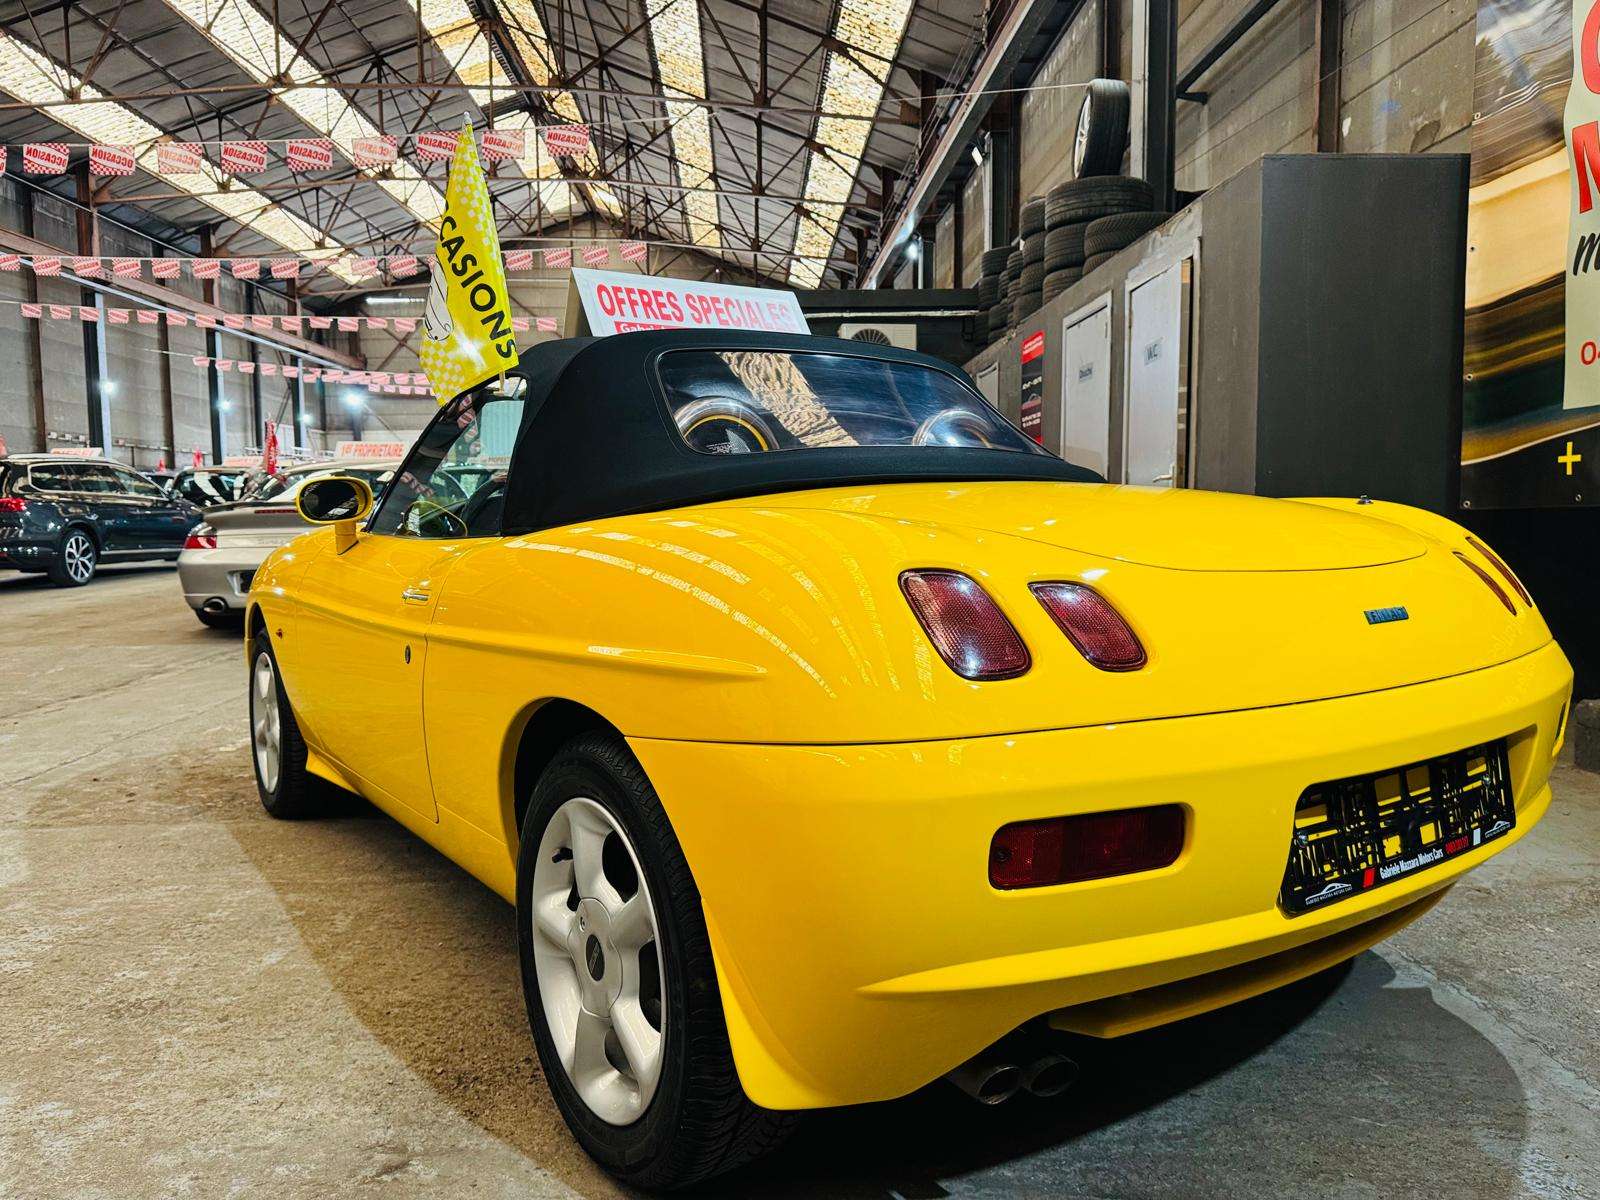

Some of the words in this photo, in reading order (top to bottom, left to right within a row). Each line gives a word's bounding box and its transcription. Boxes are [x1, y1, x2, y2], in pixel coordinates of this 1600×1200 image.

[440, 215, 517, 359] CASIONS
[596, 283, 685, 323] OFFRES
[685, 292, 797, 332] SPECIALES
[1147, 343, 1158, 361] WC
[1418, 851, 1434, 866] Motors
[1433, 848, 1444, 860] Cars
